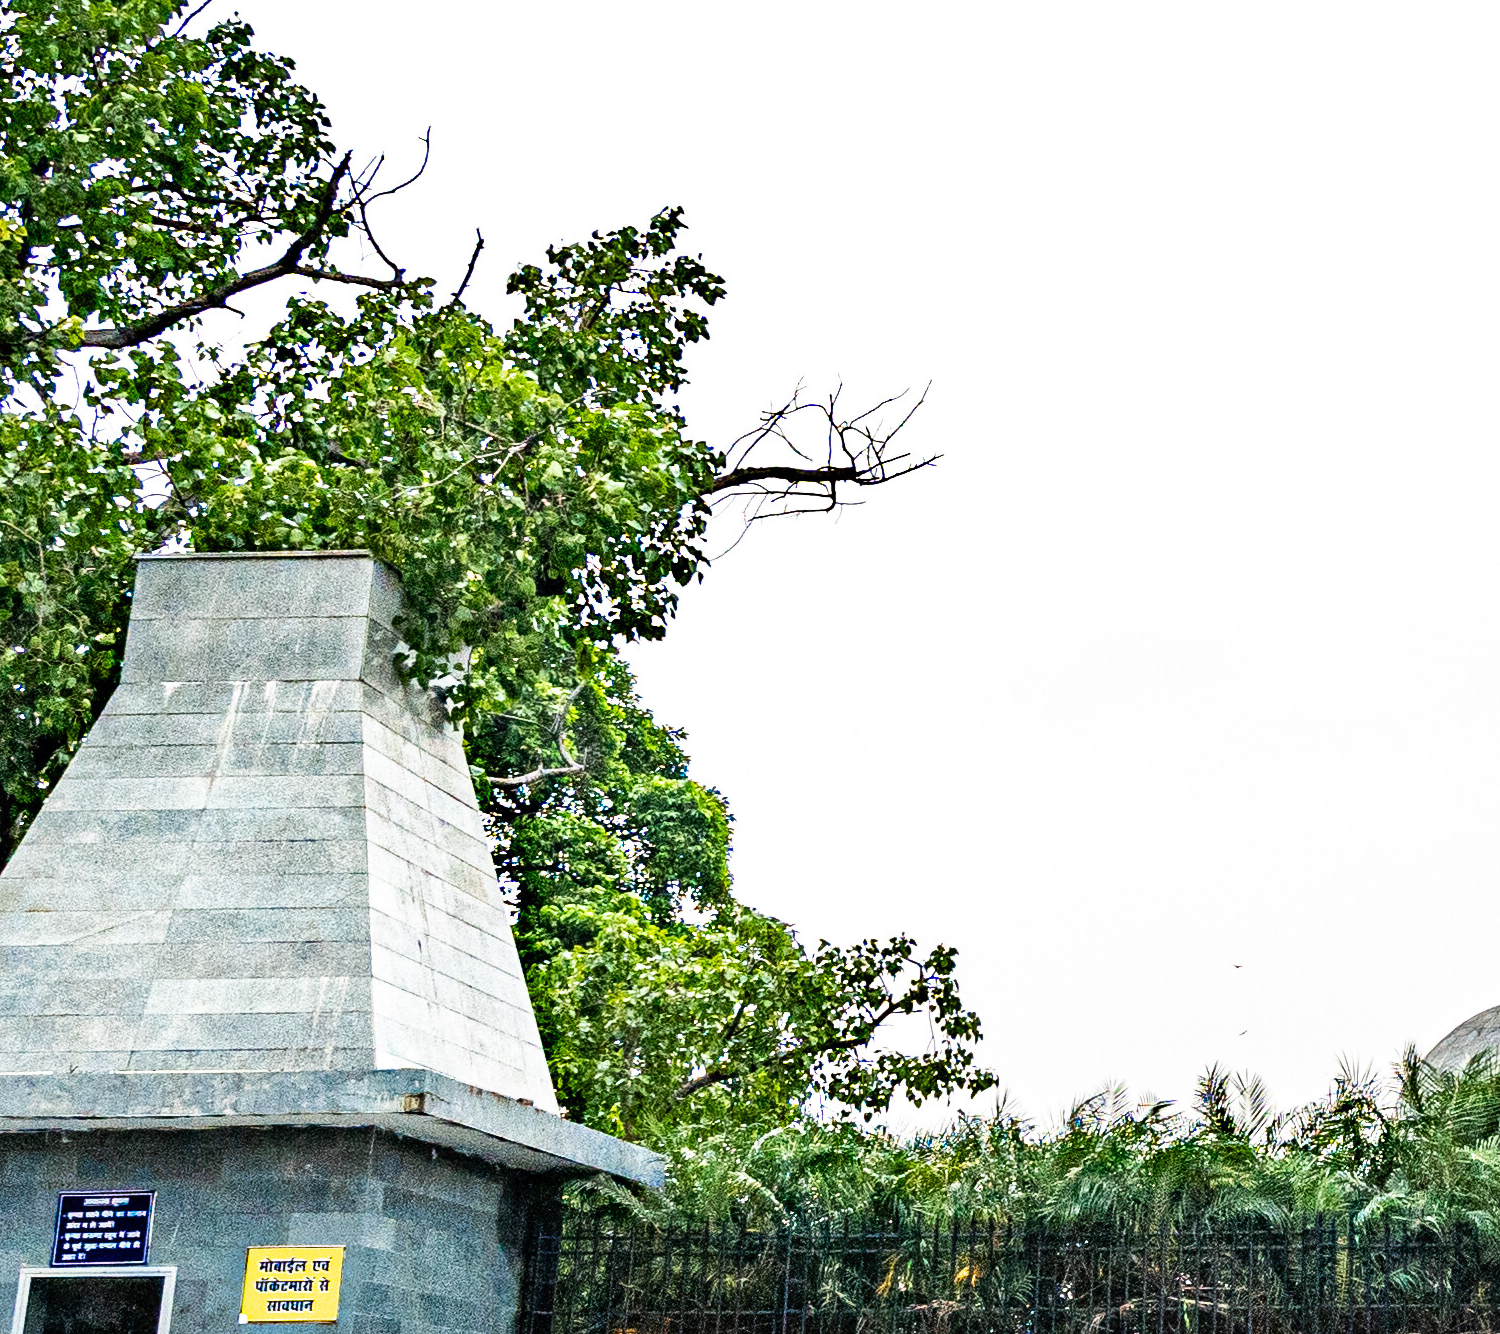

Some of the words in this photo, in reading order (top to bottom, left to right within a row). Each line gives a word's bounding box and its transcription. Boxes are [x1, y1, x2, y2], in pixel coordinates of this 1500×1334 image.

[259, 1258, 307, 1273] मोबाईल
[312, 1257, 332, 1271] एवं
[255, 1277, 315, 1292] पॉकेटमारों
[319, 1277, 330, 1291] से
[267, 1300, 314, 1311] सावधान
